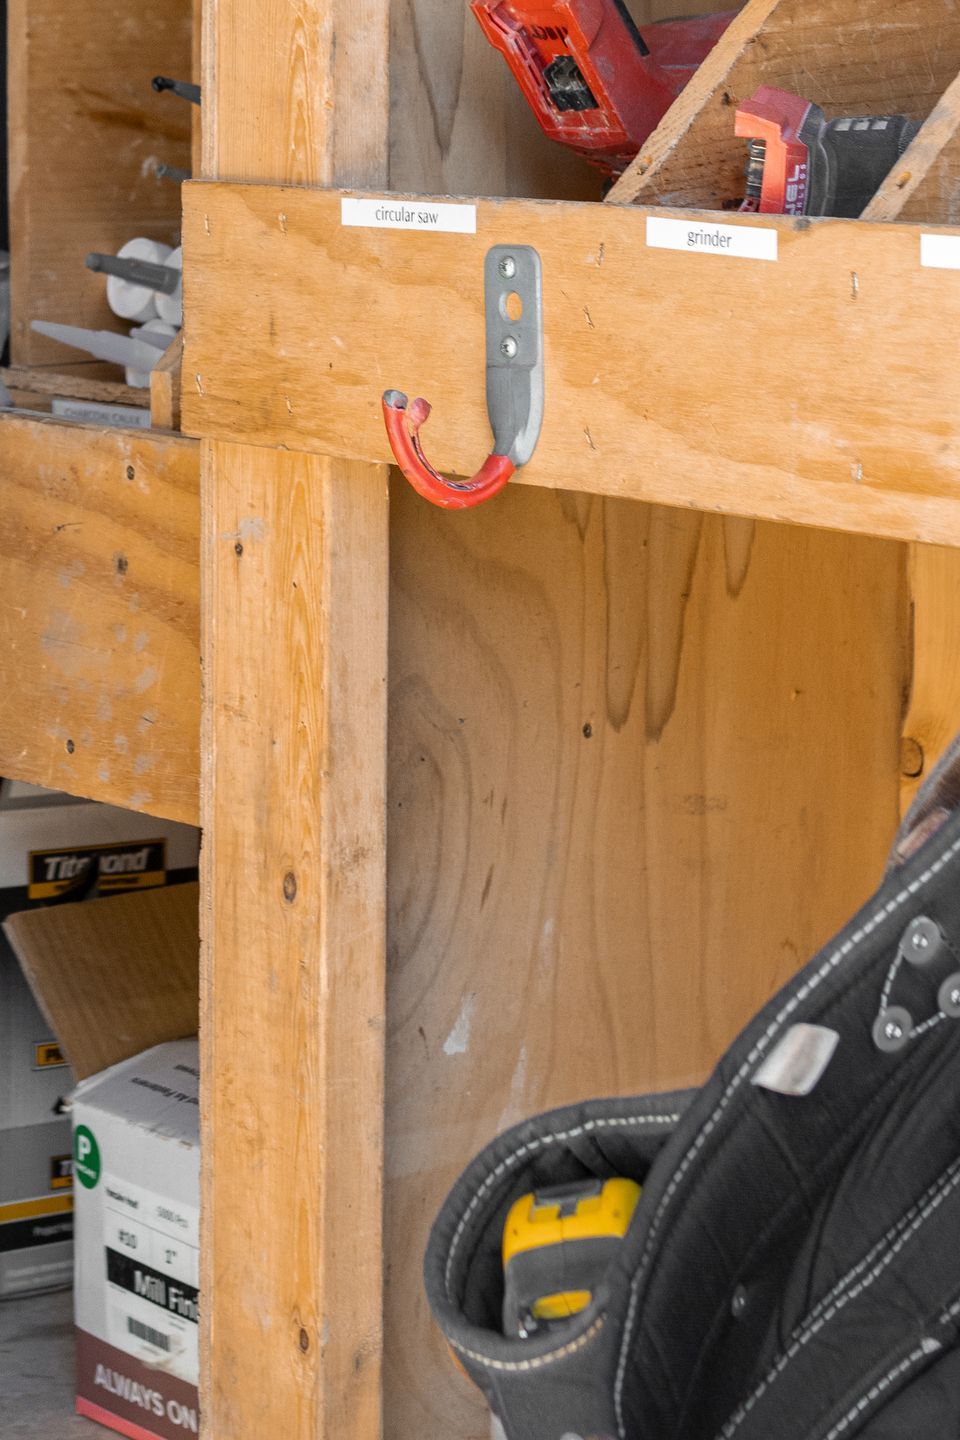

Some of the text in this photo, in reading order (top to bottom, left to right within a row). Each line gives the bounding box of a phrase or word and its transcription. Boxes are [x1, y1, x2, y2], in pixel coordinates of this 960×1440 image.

[375, 206, 439, 224] circular saw
[687, 229, 732, 248] grinder
[78, 1134, 92, 1161] P
[134, 1270, 167, 1306] Mill
[93, 1363, 198, 1434] ALWAYS ON
